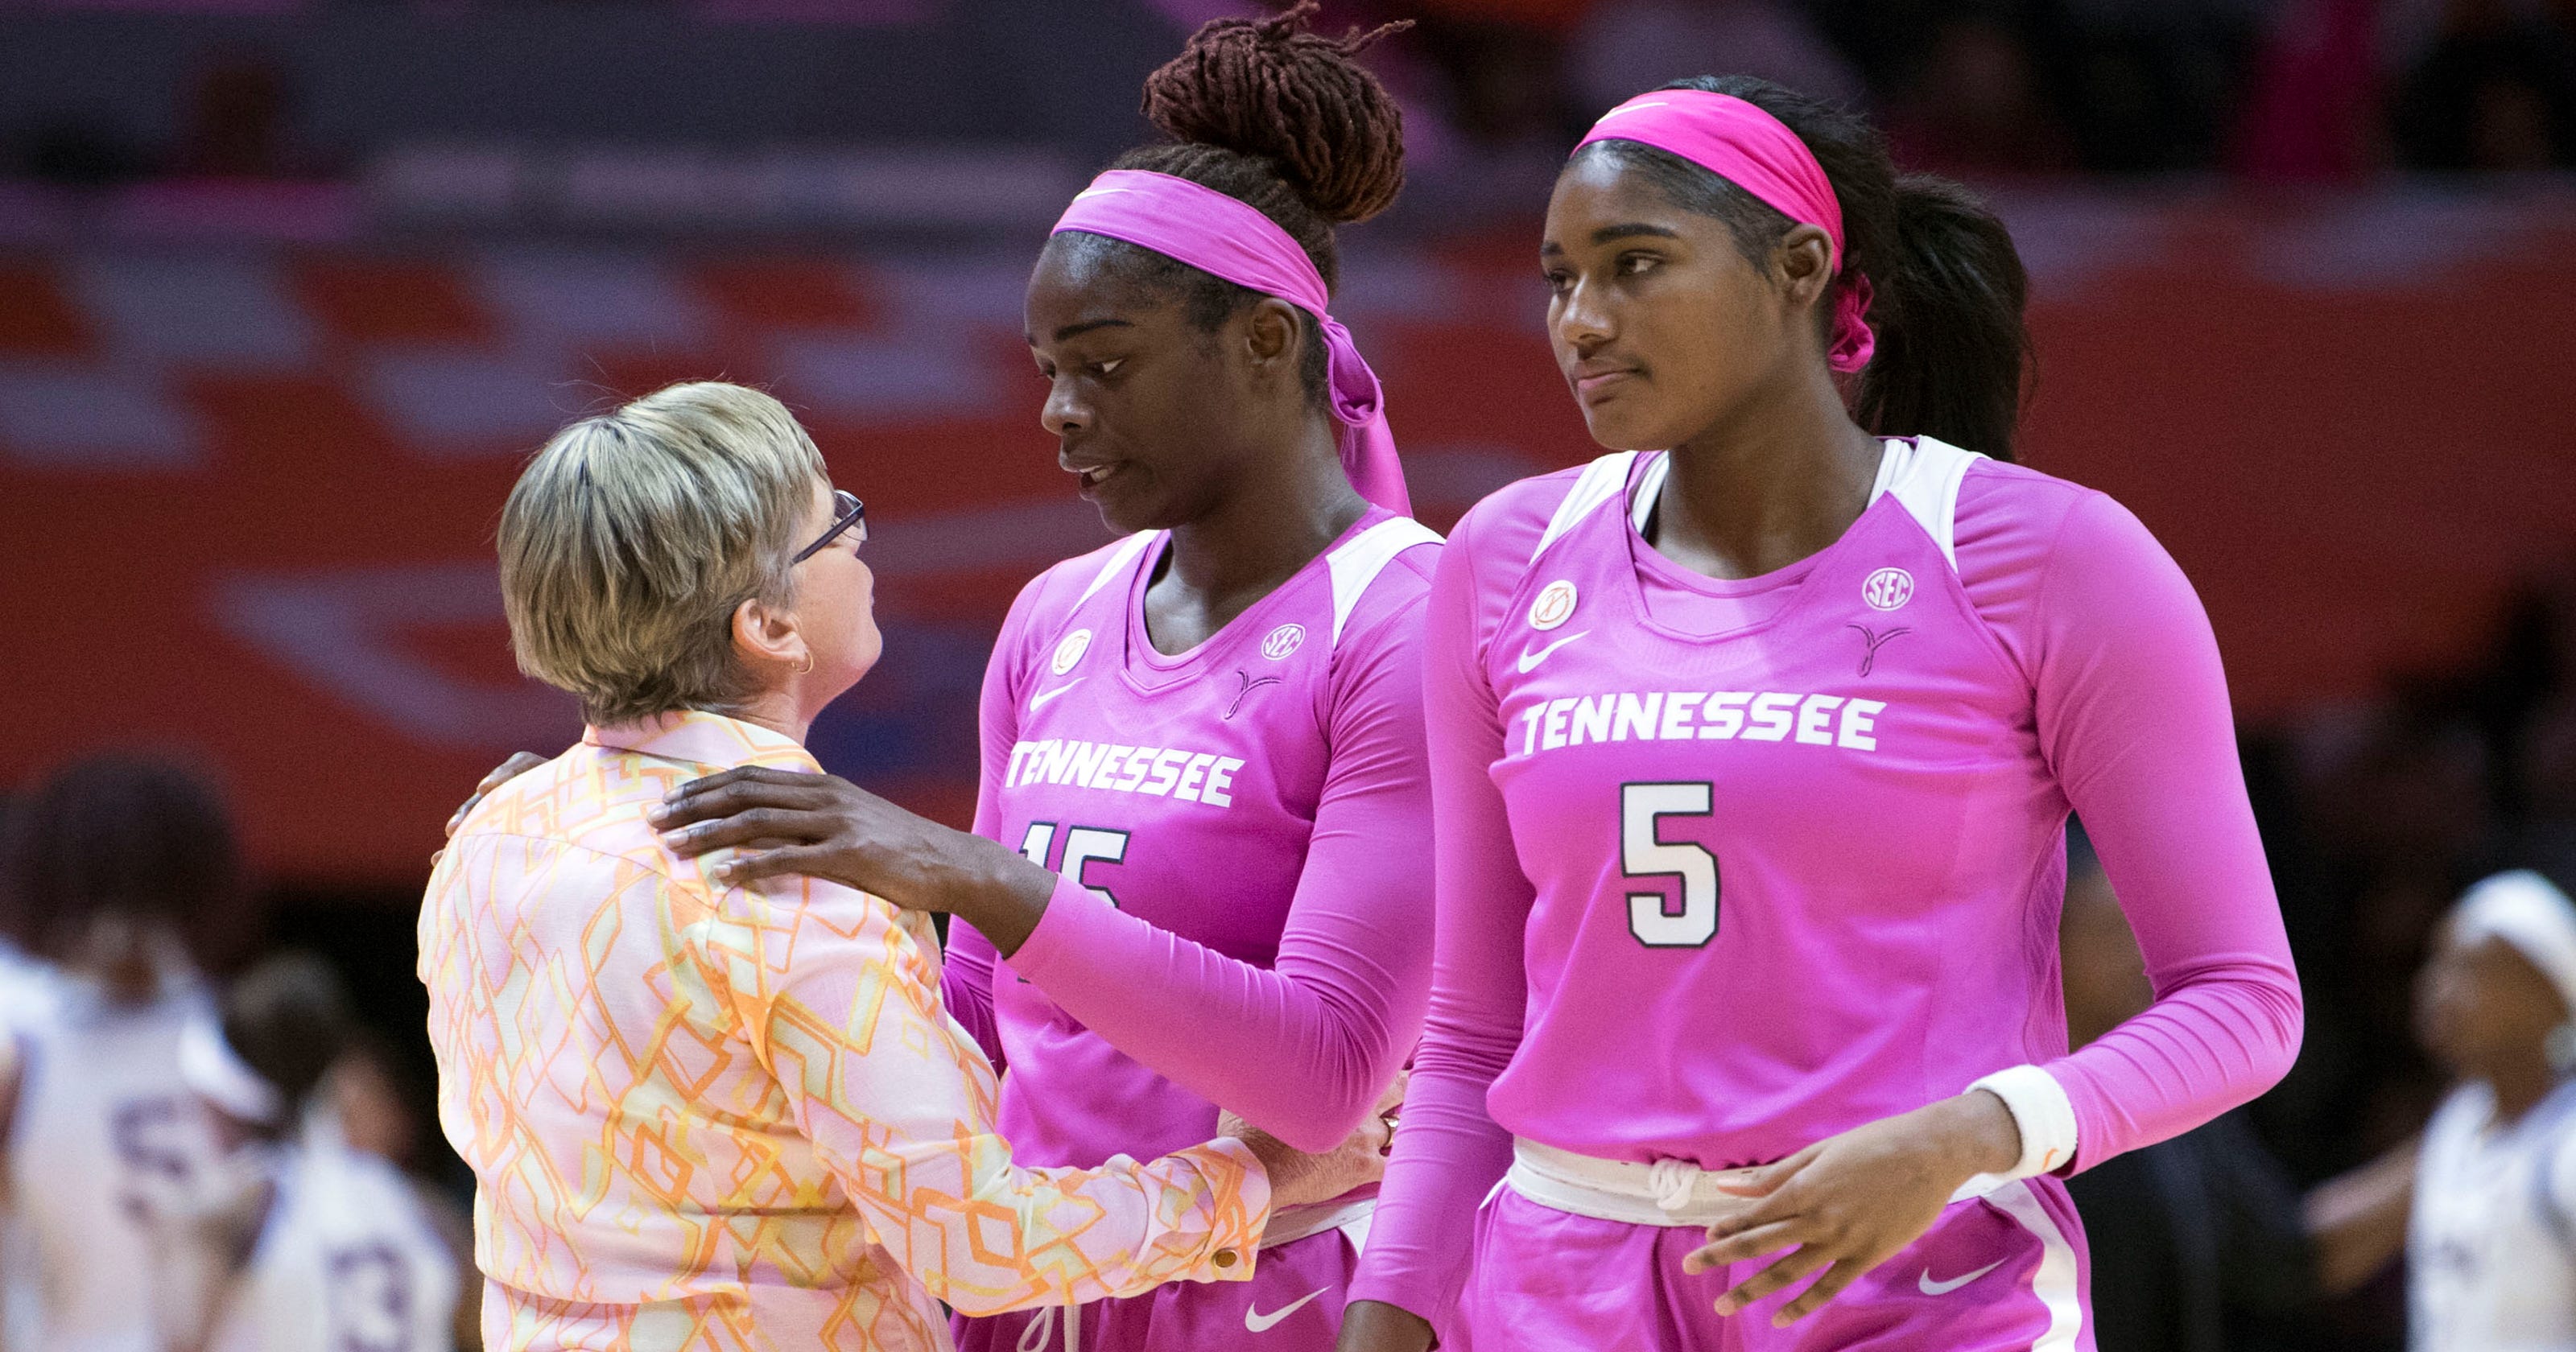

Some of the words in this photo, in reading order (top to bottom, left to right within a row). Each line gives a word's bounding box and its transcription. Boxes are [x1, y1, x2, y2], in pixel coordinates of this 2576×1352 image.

[1867, 571, 1909, 608] SEC
[1265, 625, 1302, 657] SEC
[1521, 691, 1888, 756] TENNESSEE
[1005, 739, 1246, 808] TENNESSEE
[1619, 781, 1720, 949] 5
